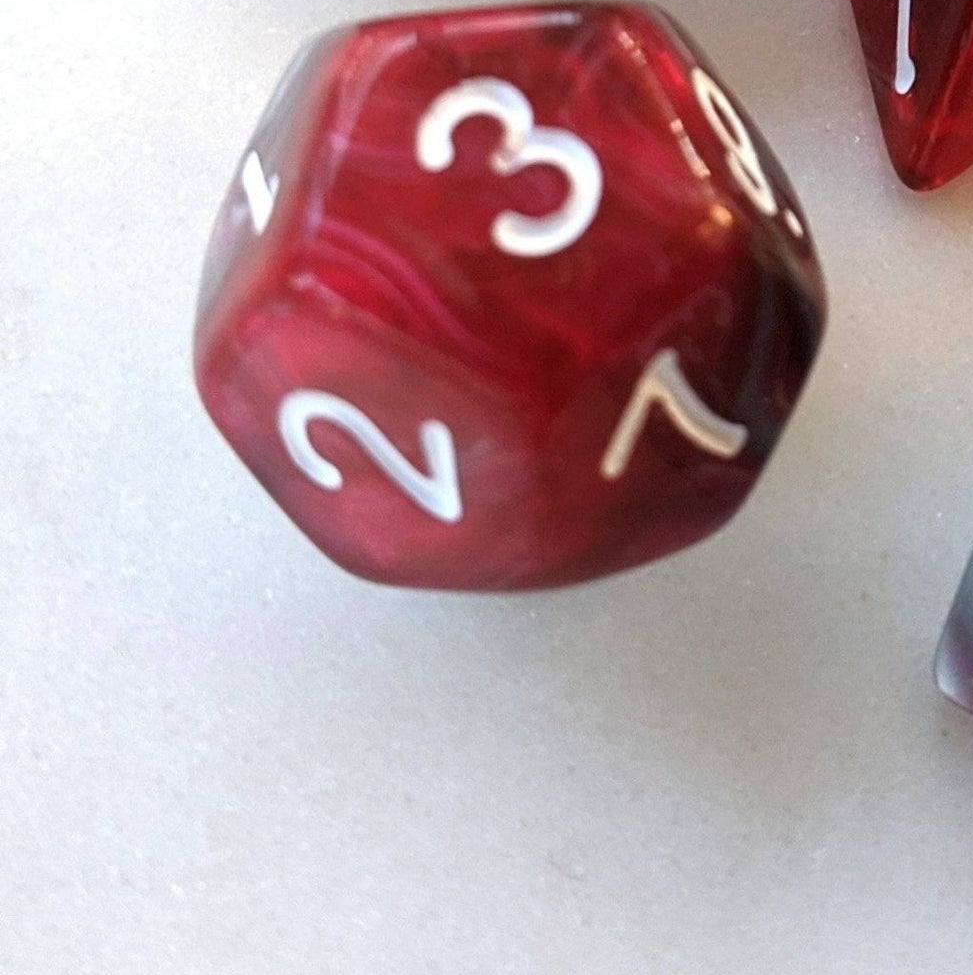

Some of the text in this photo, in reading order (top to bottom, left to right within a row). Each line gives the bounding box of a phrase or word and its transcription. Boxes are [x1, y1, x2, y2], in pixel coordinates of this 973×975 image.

[415, 76, 604, 258] 3
[278, 389, 464, 523] 2
[601, 348, 749, 480] 7
